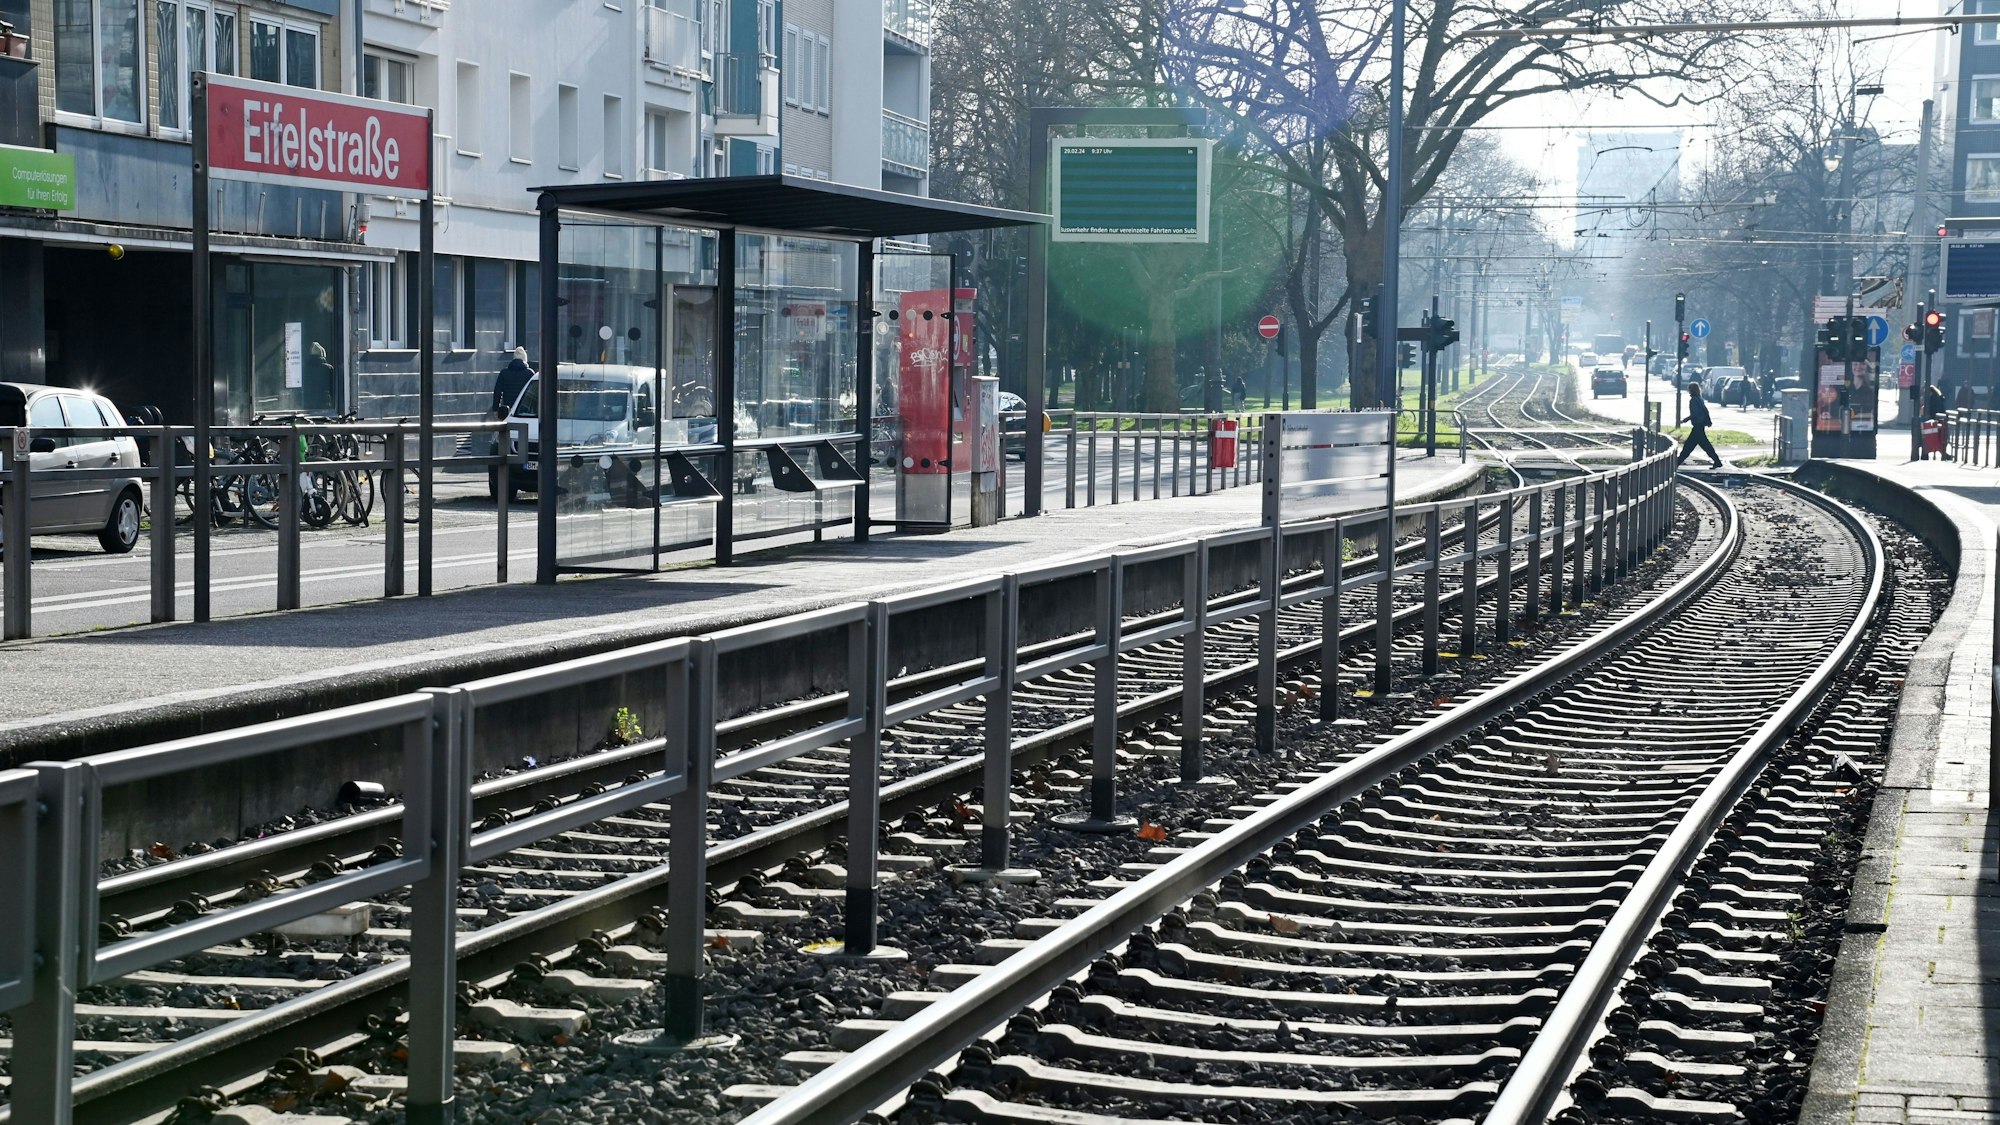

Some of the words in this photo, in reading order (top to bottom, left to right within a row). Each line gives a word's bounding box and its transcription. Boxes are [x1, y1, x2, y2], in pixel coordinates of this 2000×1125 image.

[243, 98, 400, 180] Eifelstraße
[12, 166, 68, 186] Computerlösungen
[36, 188, 51, 201] Ihren
[51, 189, 68, 206] Erfolg
